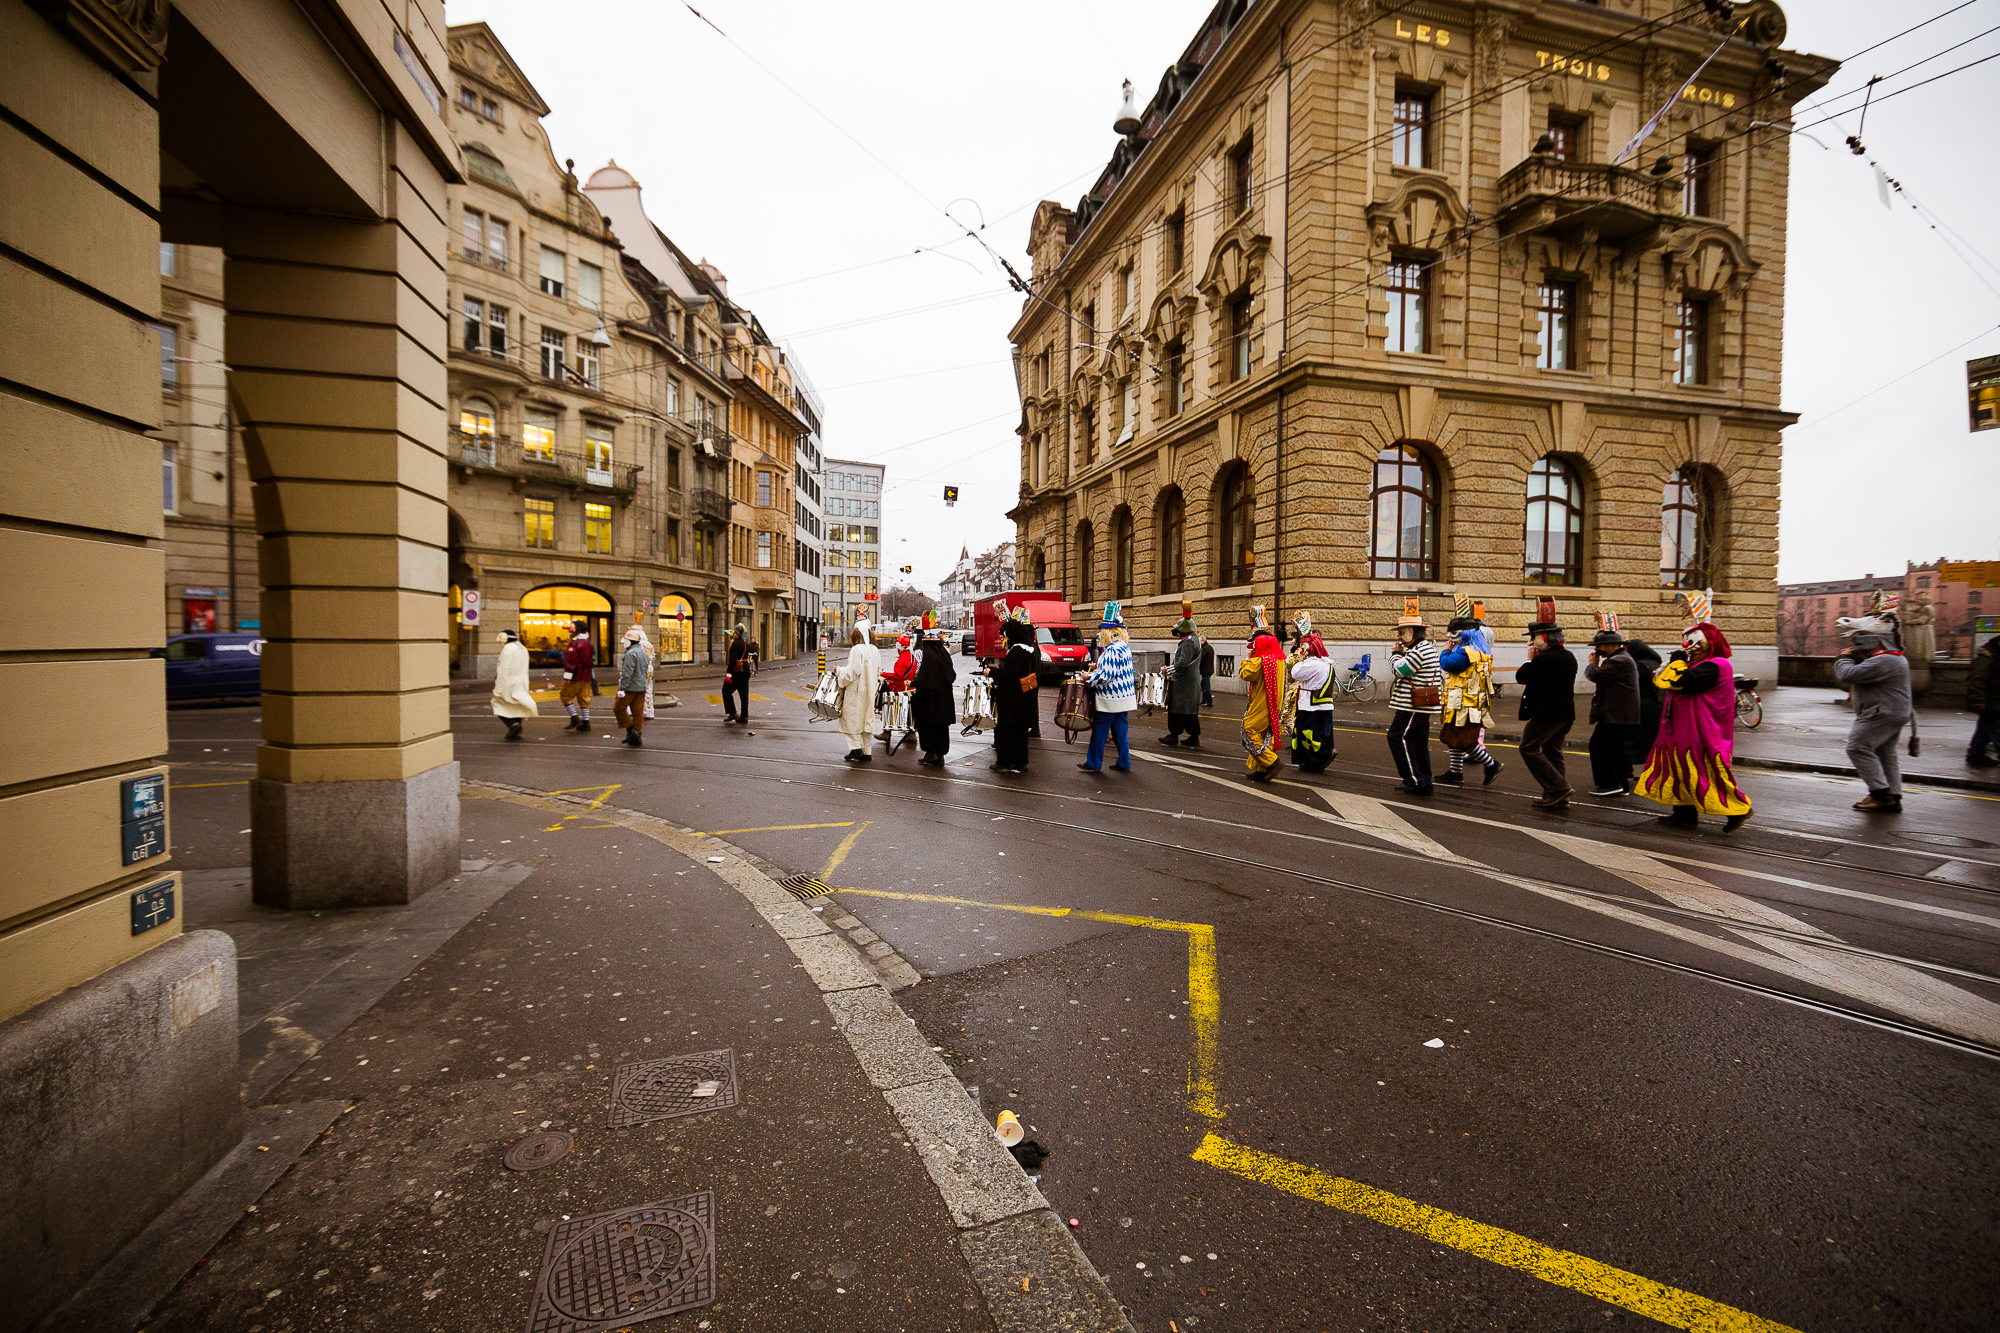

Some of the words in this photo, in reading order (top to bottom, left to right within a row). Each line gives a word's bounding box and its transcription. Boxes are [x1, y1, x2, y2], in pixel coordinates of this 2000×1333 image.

[1396, 18, 1450, 47] LES
[1535, 50, 1610, 82] TROIS
[1682, 83, 1736, 110] ROIS
[142, 830, 155, 843] 1.2
[132, 848, 145, 861] 0.6
[151, 898, 165, 911] 0.9
[644, 1225, 680, 1281] HYDRANT
